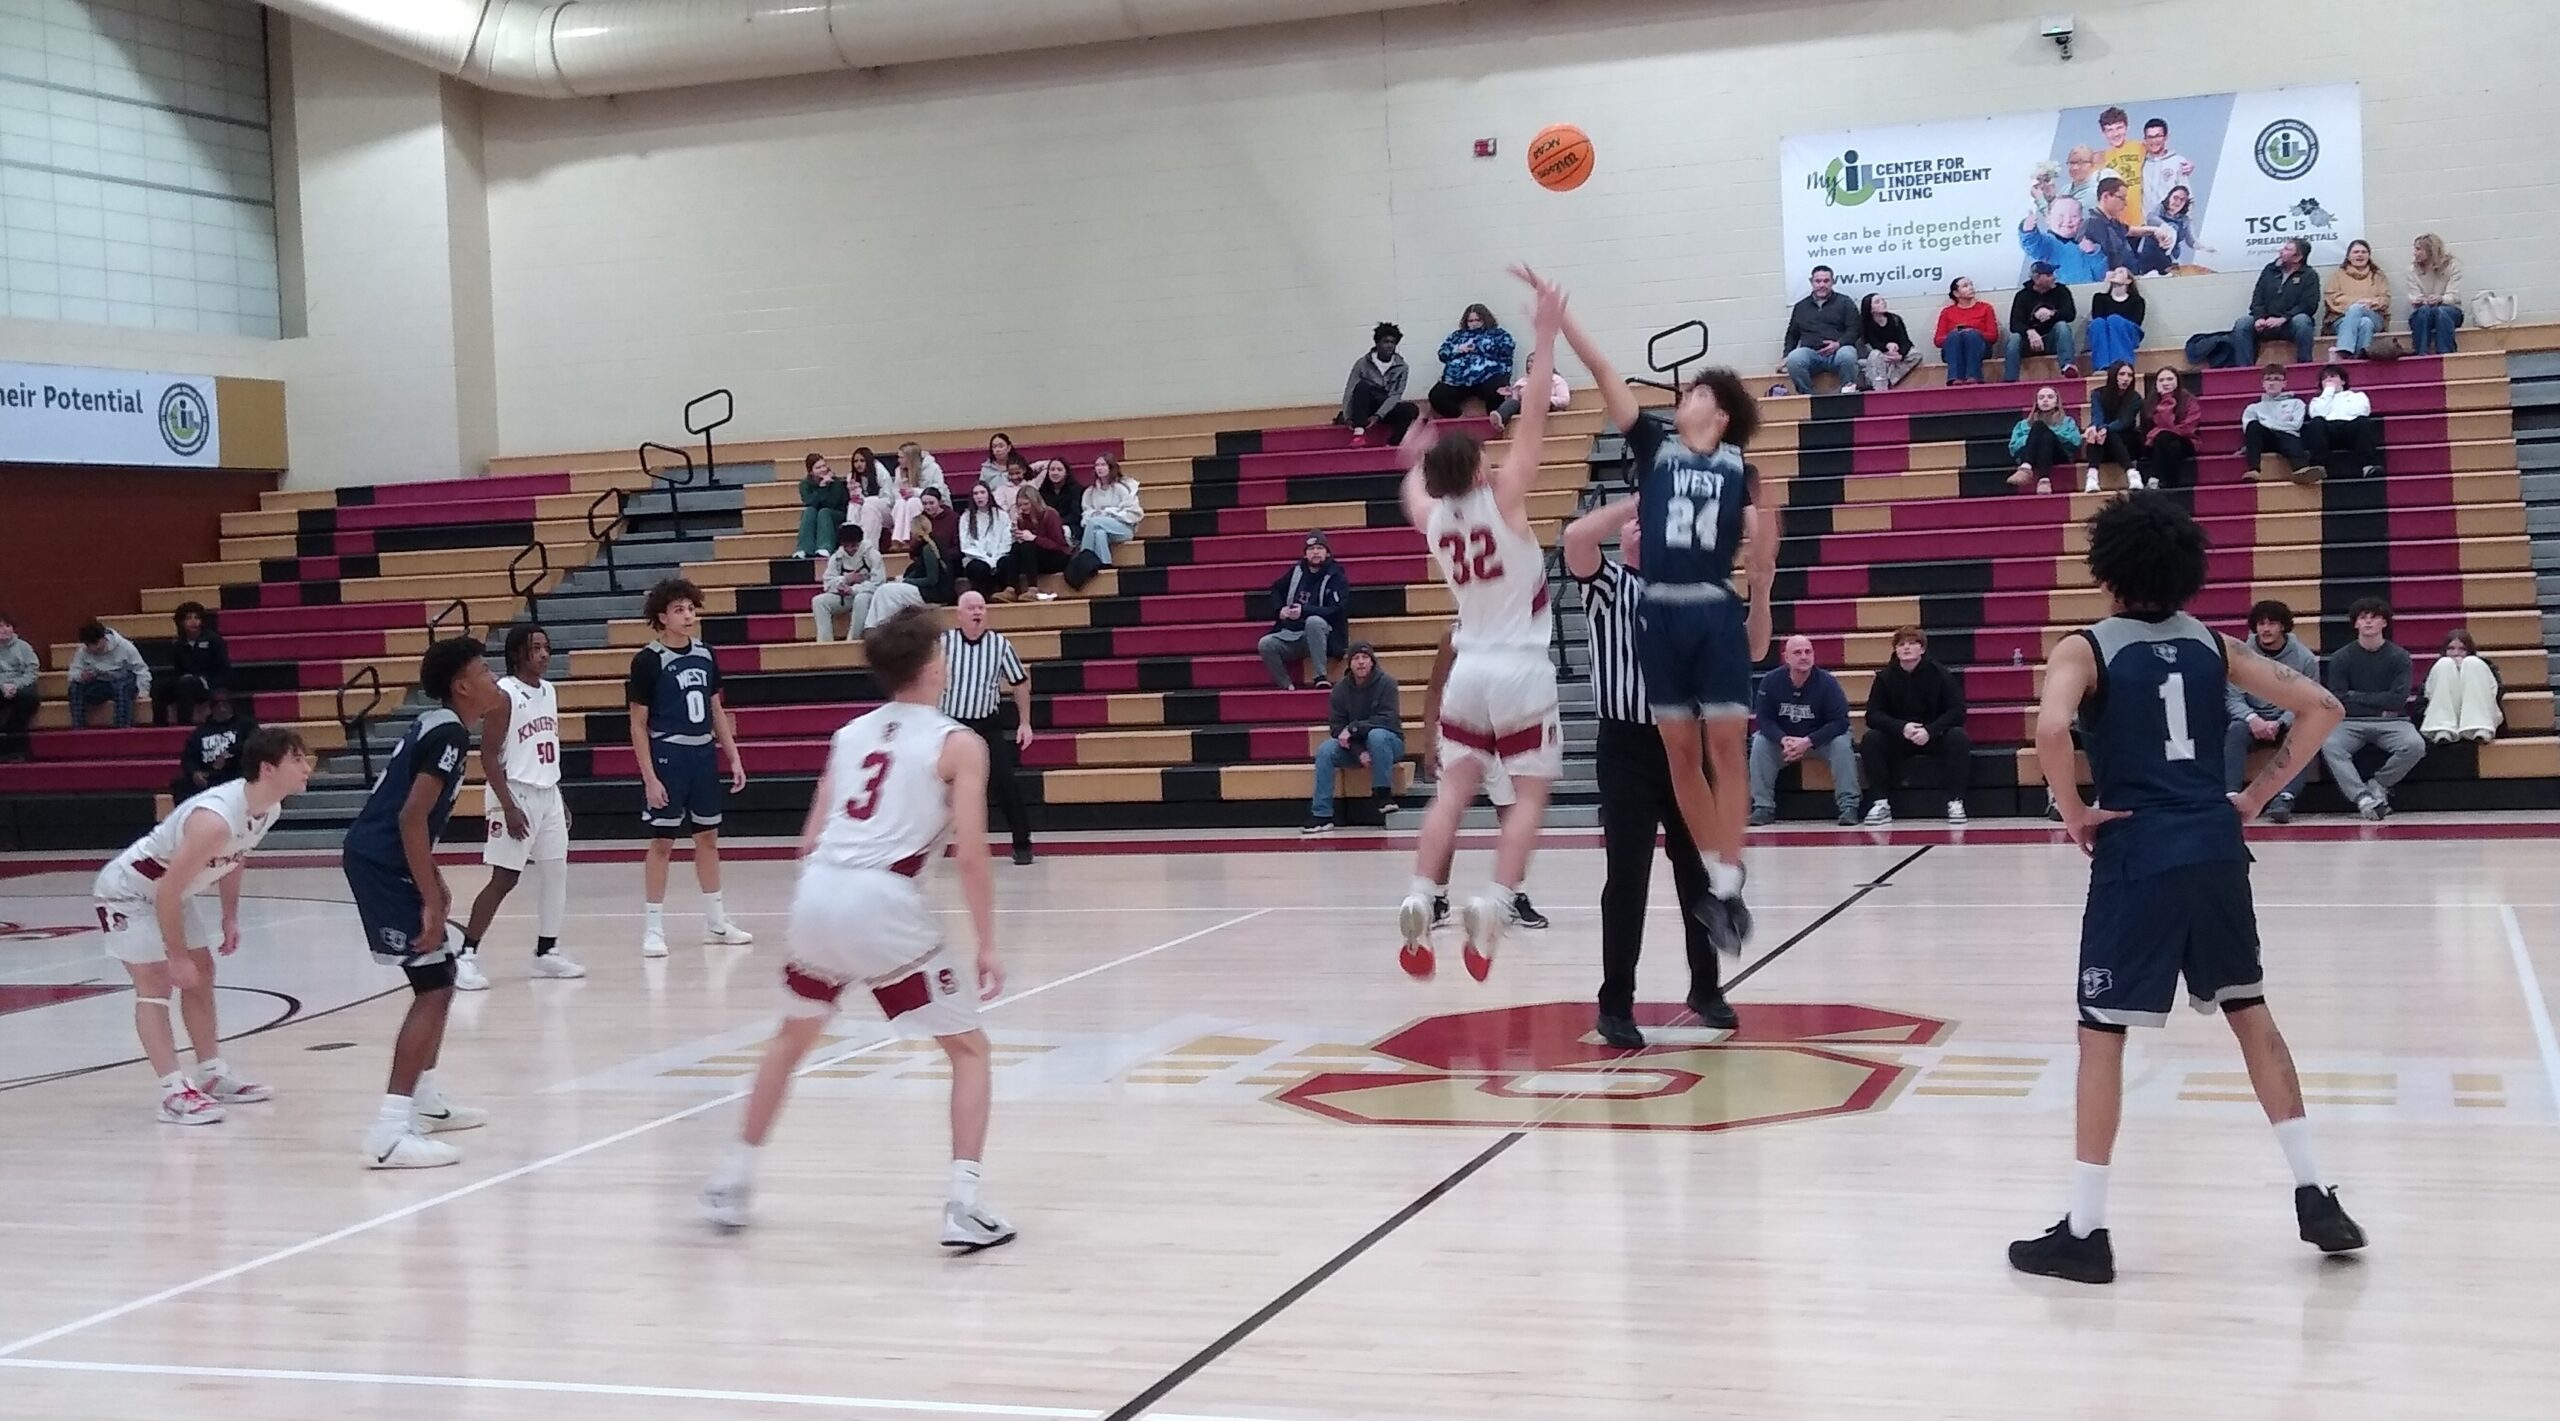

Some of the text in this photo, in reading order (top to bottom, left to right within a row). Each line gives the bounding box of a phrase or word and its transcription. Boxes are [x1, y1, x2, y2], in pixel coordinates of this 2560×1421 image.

[1537, 152, 1578, 179] Wilson
[1876, 157, 1965, 176] CENTER FOR
[1888, 168, 1992, 188] INDEPENDENT
[1878, 187, 1934, 203] LIVING
[1807, 216, 2001, 244] we can be independent
[2245, 215, 2307, 234] TSC IS
[1807, 231, 2002, 259] when we do it together
[44, 385, 144, 414] Potential
[1673, 468, 1725, 499] WEST
[1665, 498, 1720, 550] 24
[1438, 527, 1504, 585] 32
[676, 668, 708, 690] WEST
[686, 691, 706, 724] 0
[2158, 672, 2196, 762] 1
[536, 741, 556, 765] 50
[846, 751, 891, 821] 3
